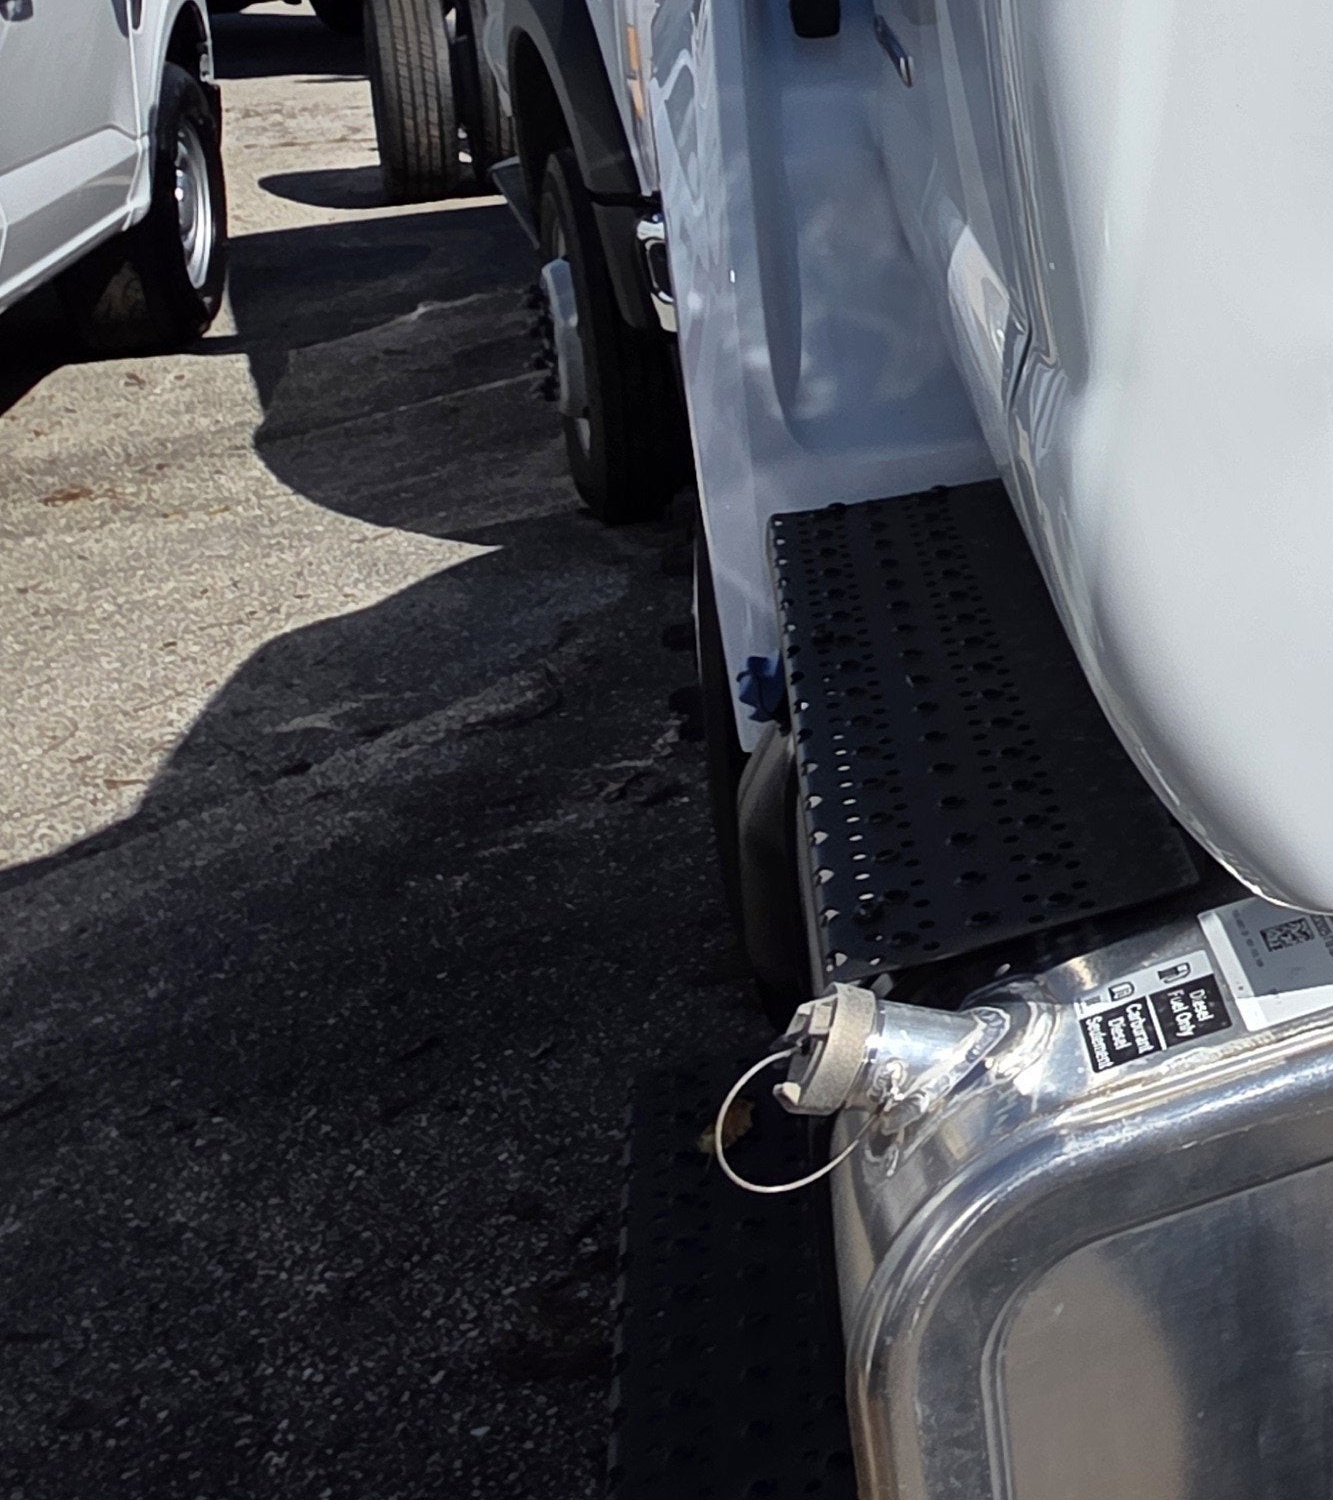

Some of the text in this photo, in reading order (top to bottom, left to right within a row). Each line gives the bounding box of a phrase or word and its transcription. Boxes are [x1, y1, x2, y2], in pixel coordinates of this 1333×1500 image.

[1124, 1002, 1154, 1055] Carburant
[1166, 988, 1196, 1038] Fuel Only
[1188, 987, 1214, 1023] Diesel
[1085, 1015, 1115, 1070] Seulement
[1107, 1014, 1132, 1051] Diesel
